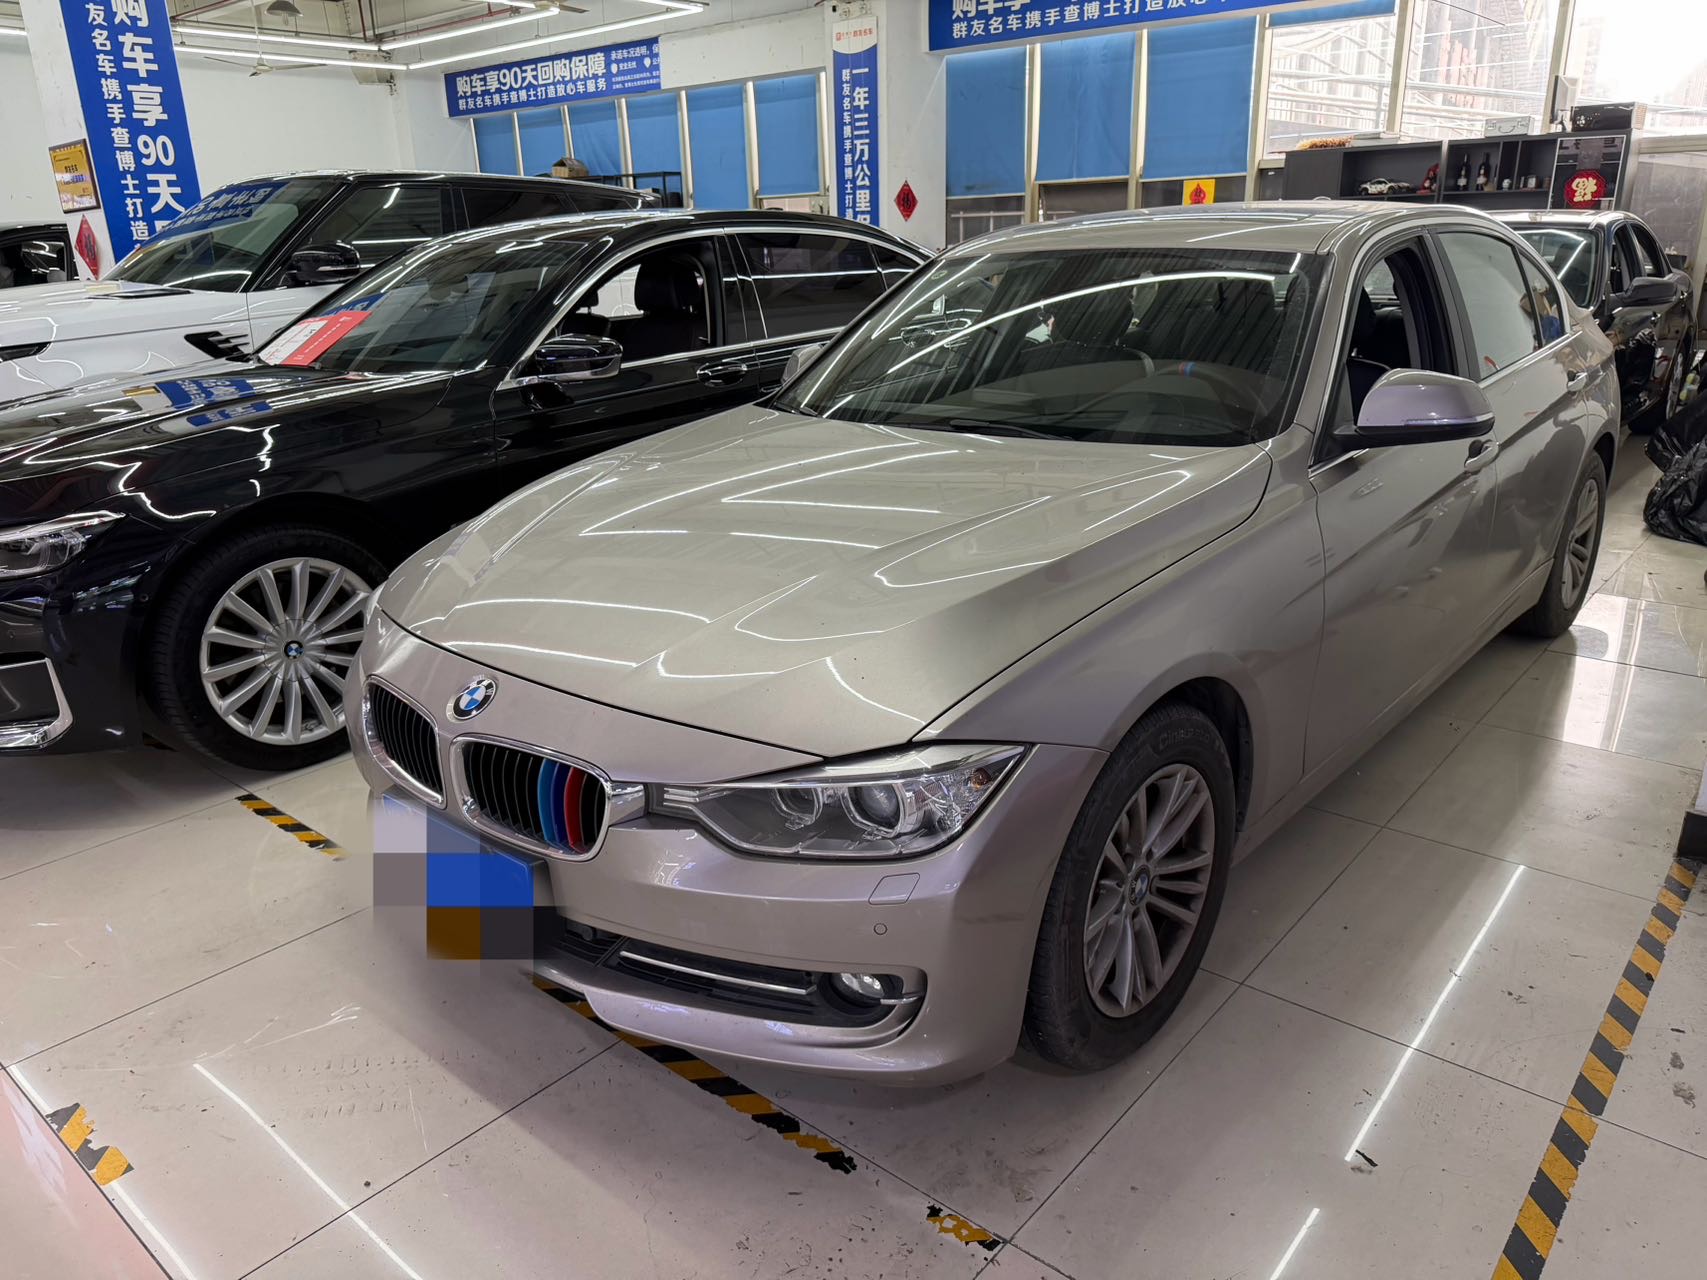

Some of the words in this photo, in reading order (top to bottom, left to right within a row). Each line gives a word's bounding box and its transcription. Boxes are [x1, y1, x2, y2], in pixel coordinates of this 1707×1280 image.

[952, 0, 1223, 38] 群友名车携手查博士打造放
[456, 52, 606, 97] 购车享90天回购保障
[458, 78, 607, 110] 群友名车携手查博士打造放心车服务
[85, 3, 150, 247] 友名车携手查博士打造
[112, 0, 185, 229] 购车享90天
